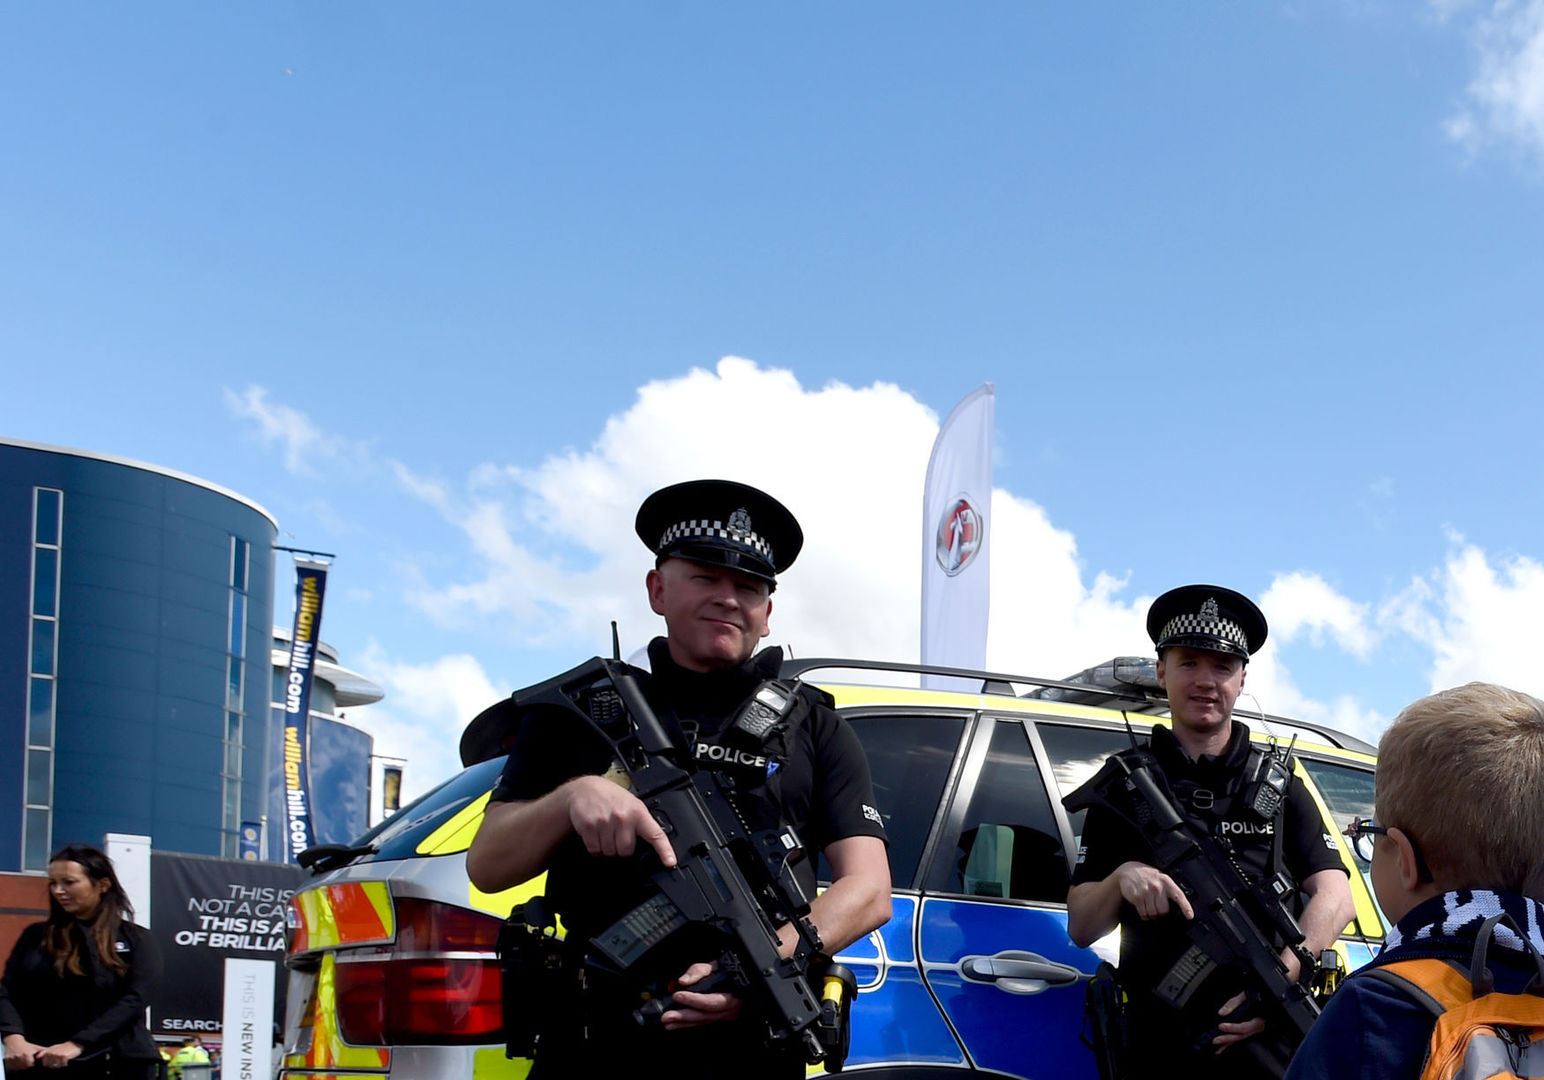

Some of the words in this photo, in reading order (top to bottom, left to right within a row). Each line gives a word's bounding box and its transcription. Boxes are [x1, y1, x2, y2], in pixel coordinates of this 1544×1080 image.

[287, 577, 320, 714] williamhill.com
[695, 742, 767, 768] POLICE
[1221, 821, 1275, 835] POLICE
[228, 883, 275, 903] THIS
[277, 888, 295, 904] IS
[188, 897, 235, 915] NOT
[235, 901, 252, 916] A
[254, 903, 286, 919] CA
[200, 915, 249, 934] THIS
[249, 919, 268, 935] IS
[175, 930, 209, 947] OF
[208, 932, 286, 952] BRILLIA
[241, 974, 256, 1004] THIS
[241, 1006, 255, 1020] IS
[240, 1022, 254, 1055] NEW
